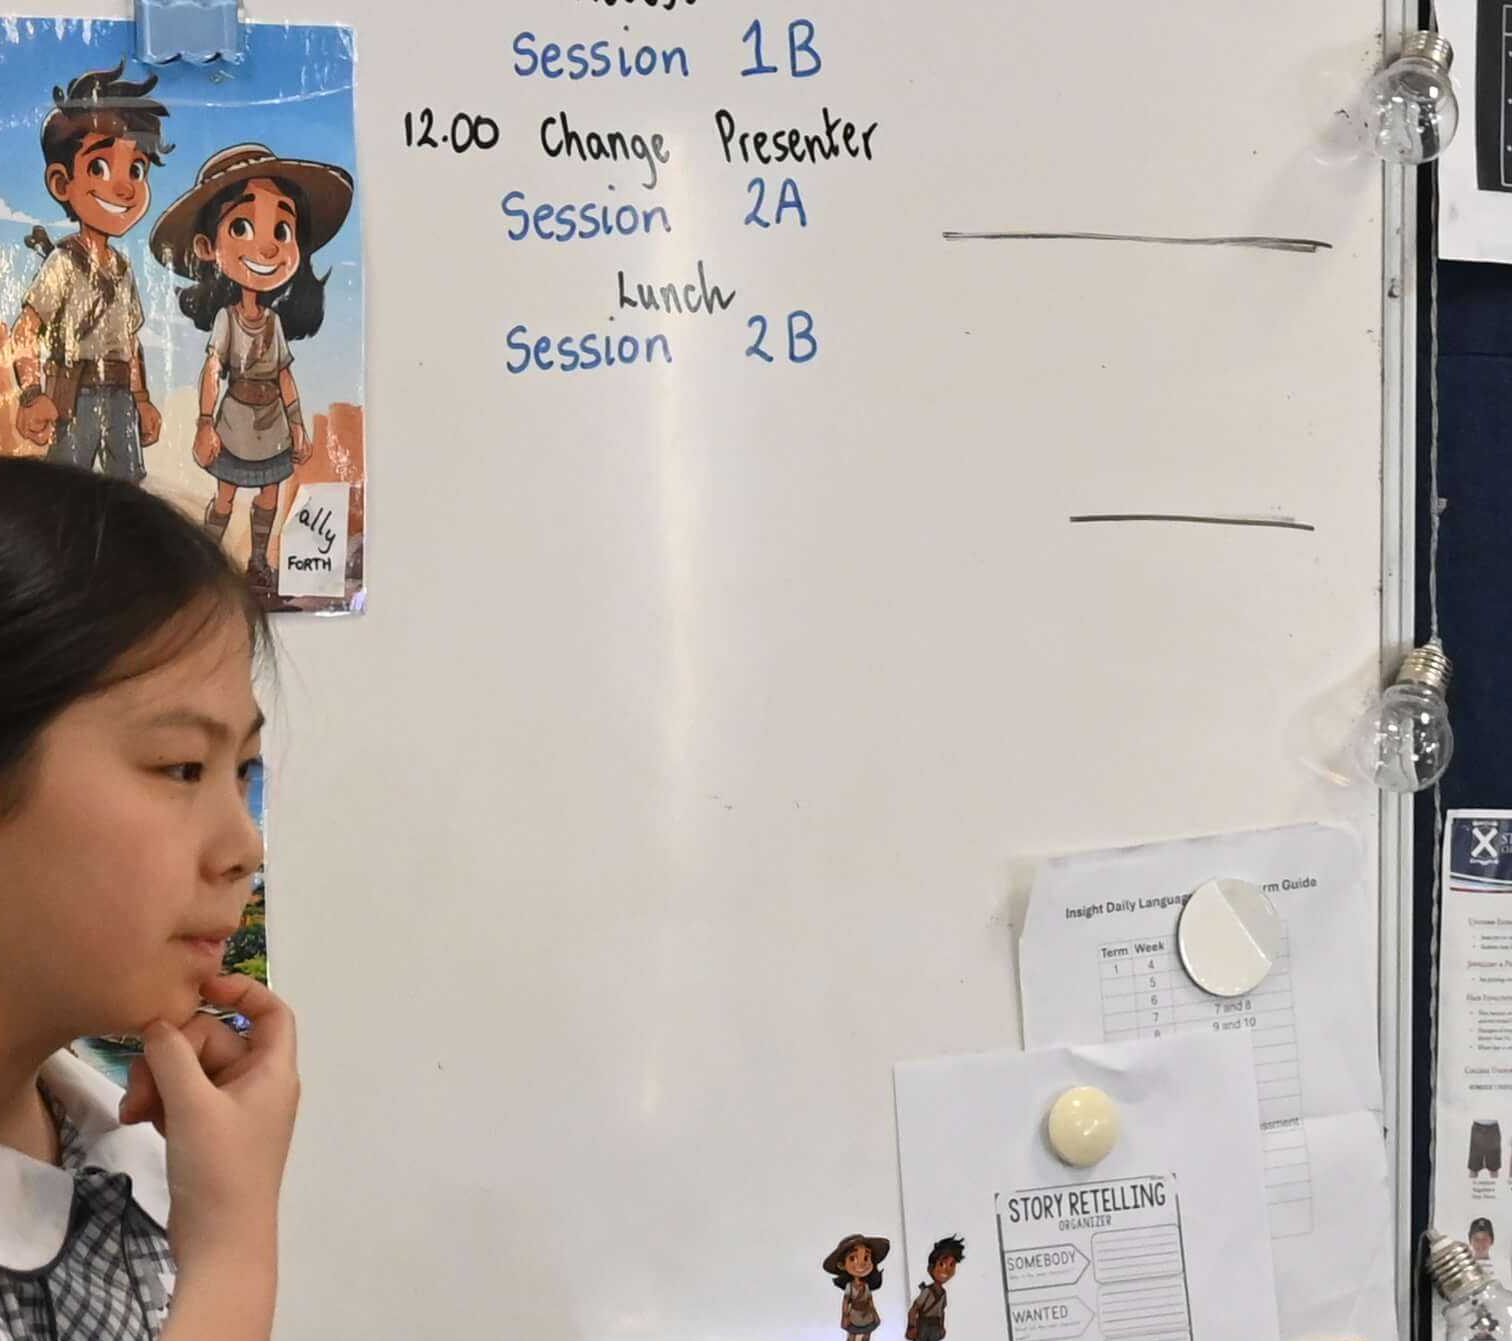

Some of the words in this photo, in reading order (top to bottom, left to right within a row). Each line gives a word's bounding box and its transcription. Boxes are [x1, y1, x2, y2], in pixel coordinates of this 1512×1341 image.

[513, 28, 688, 80] Session
[742, 19, 822, 78] 1B
[404, 108, 499, 153] 12.00
[541, 111, 670, 189] Change
[714, 107, 878, 163] Presenter
[501, 185, 672, 242] Session
[744, 177, 808, 228] 2A
[617, 260, 736, 315] Lunch
[506, 316, 672, 374] Session
[746, 310, 818, 364] 2B
[288, 555, 332, 571] FORTH
[1282, 877, 1318, 892] Guide
[1065, 904, 1104, 920] Insight
[1106, 899, 1136, 914] Daily
[1100, 946, 1128, 959] Term
[1134, 941, 1165, 954] Week
[1148, 960, 1155, 971] 4
[1152, 1012, 1160, 1023] 7
[1223, 1001, 1244, 1014] and
[1243, 1016, 1257, 1028] 10
[1008, 1192, 1064, 1224] STORY
[1068, 1182, 1166, 1217] RETELLING
[1058, 1214, 1112, 1232] ORGANIZER
[1006, 1250, 1076, 1272] SOMEBODY
[1012, 1304, 1068, 1325] WANTED
